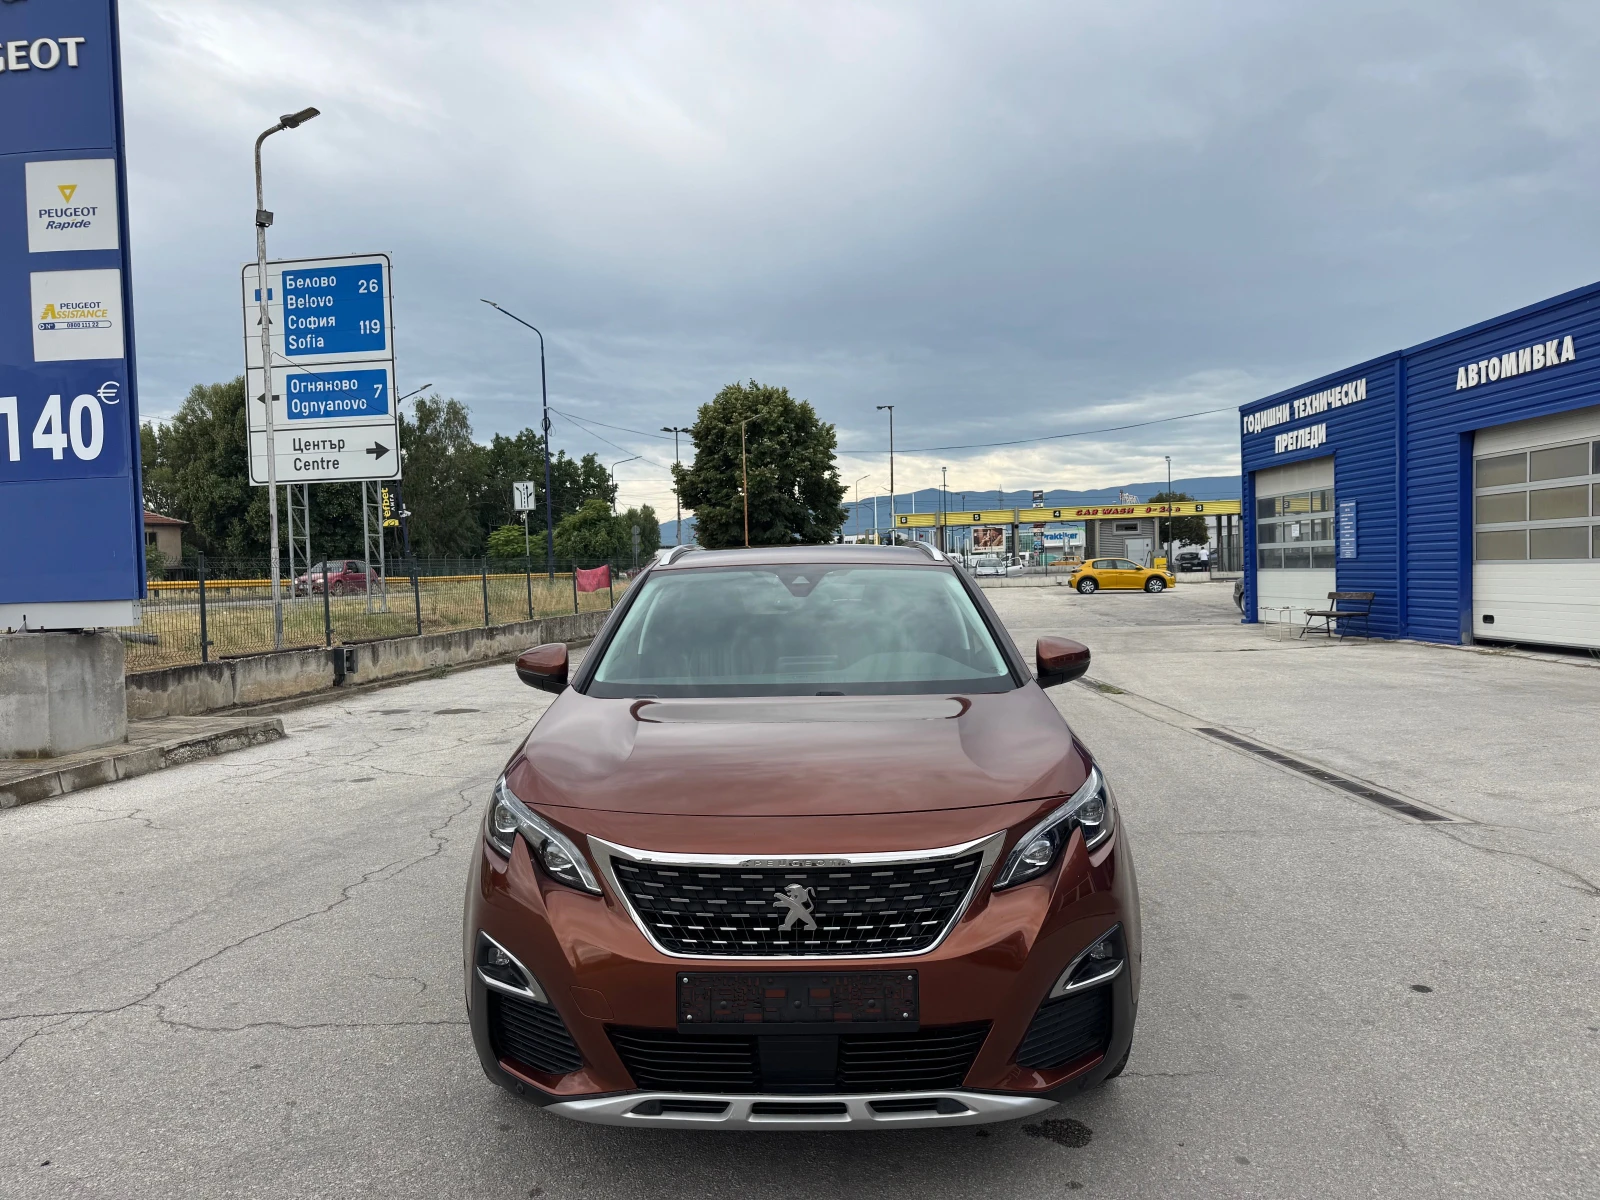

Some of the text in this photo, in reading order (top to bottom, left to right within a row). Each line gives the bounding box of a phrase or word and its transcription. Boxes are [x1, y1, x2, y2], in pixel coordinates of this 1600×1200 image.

[0, 37, 85, 73] EOT
[39, 207, 98, 218] PEUGEOT
[46, 219, 91, 230] Rapide
[286, 276, 379, 293] Белово 26
[287, 294, 334, 309] Belovo
[288, 315, 380, 334] София 119
[288, 334, 324, 349] Sofia
[1456, 335, 1576, 391] АВТОМИВКА
[291, 379, 383, 398] Огняново 7
[292, 398, 367, 416] Ognyanovo
[1243, 378, 1367, 434] ГОДИШНИ ТЕХНИЧЕСКИ
[293, 438, 346, 453] Център
[1275, 423, 1327, 454] ПРЕГЛЕДИ
[294, 457, 340, 471] Centre
